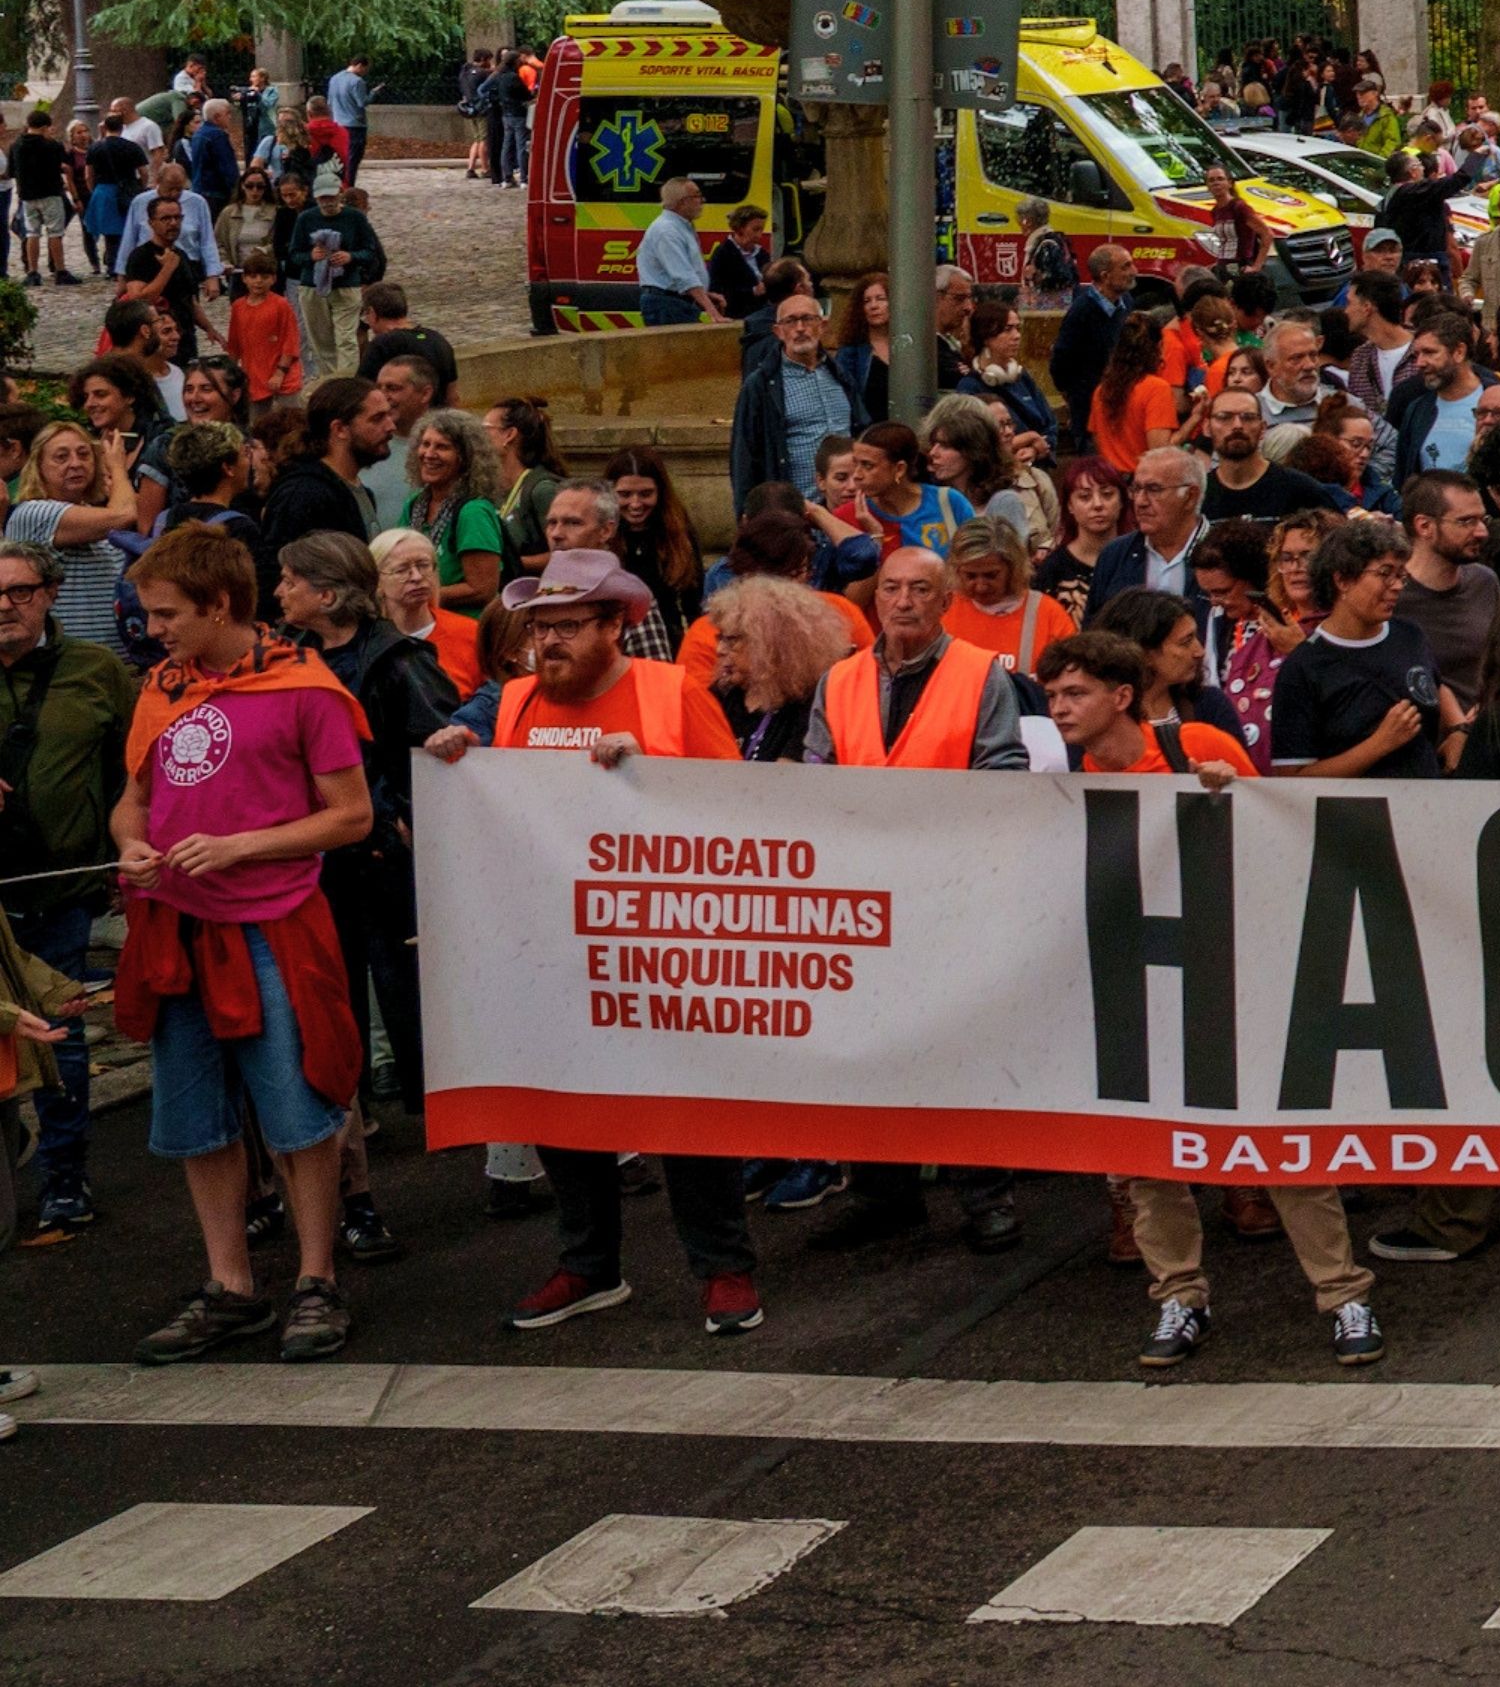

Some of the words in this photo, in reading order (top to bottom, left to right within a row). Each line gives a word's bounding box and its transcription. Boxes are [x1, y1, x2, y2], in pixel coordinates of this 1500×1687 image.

[640, 65, 691, 76] SOPORTE
[696, 66, 728, 76] VITAL
[704, 115, 729, 132] 112
[589, 833, 815, 879] SINDICATO
[587, 890, 641, 928] DE
[650, 892, 883, 939] INQUILINAS
[588, 945, 610, 981] E
[619, 946, 854, 991] INQUILINOS
[591, 991, 641, 1028] DE
[650, 995, 811, 1037] MADRID
[1172, 1129, 1500, 1174] BAJADA
